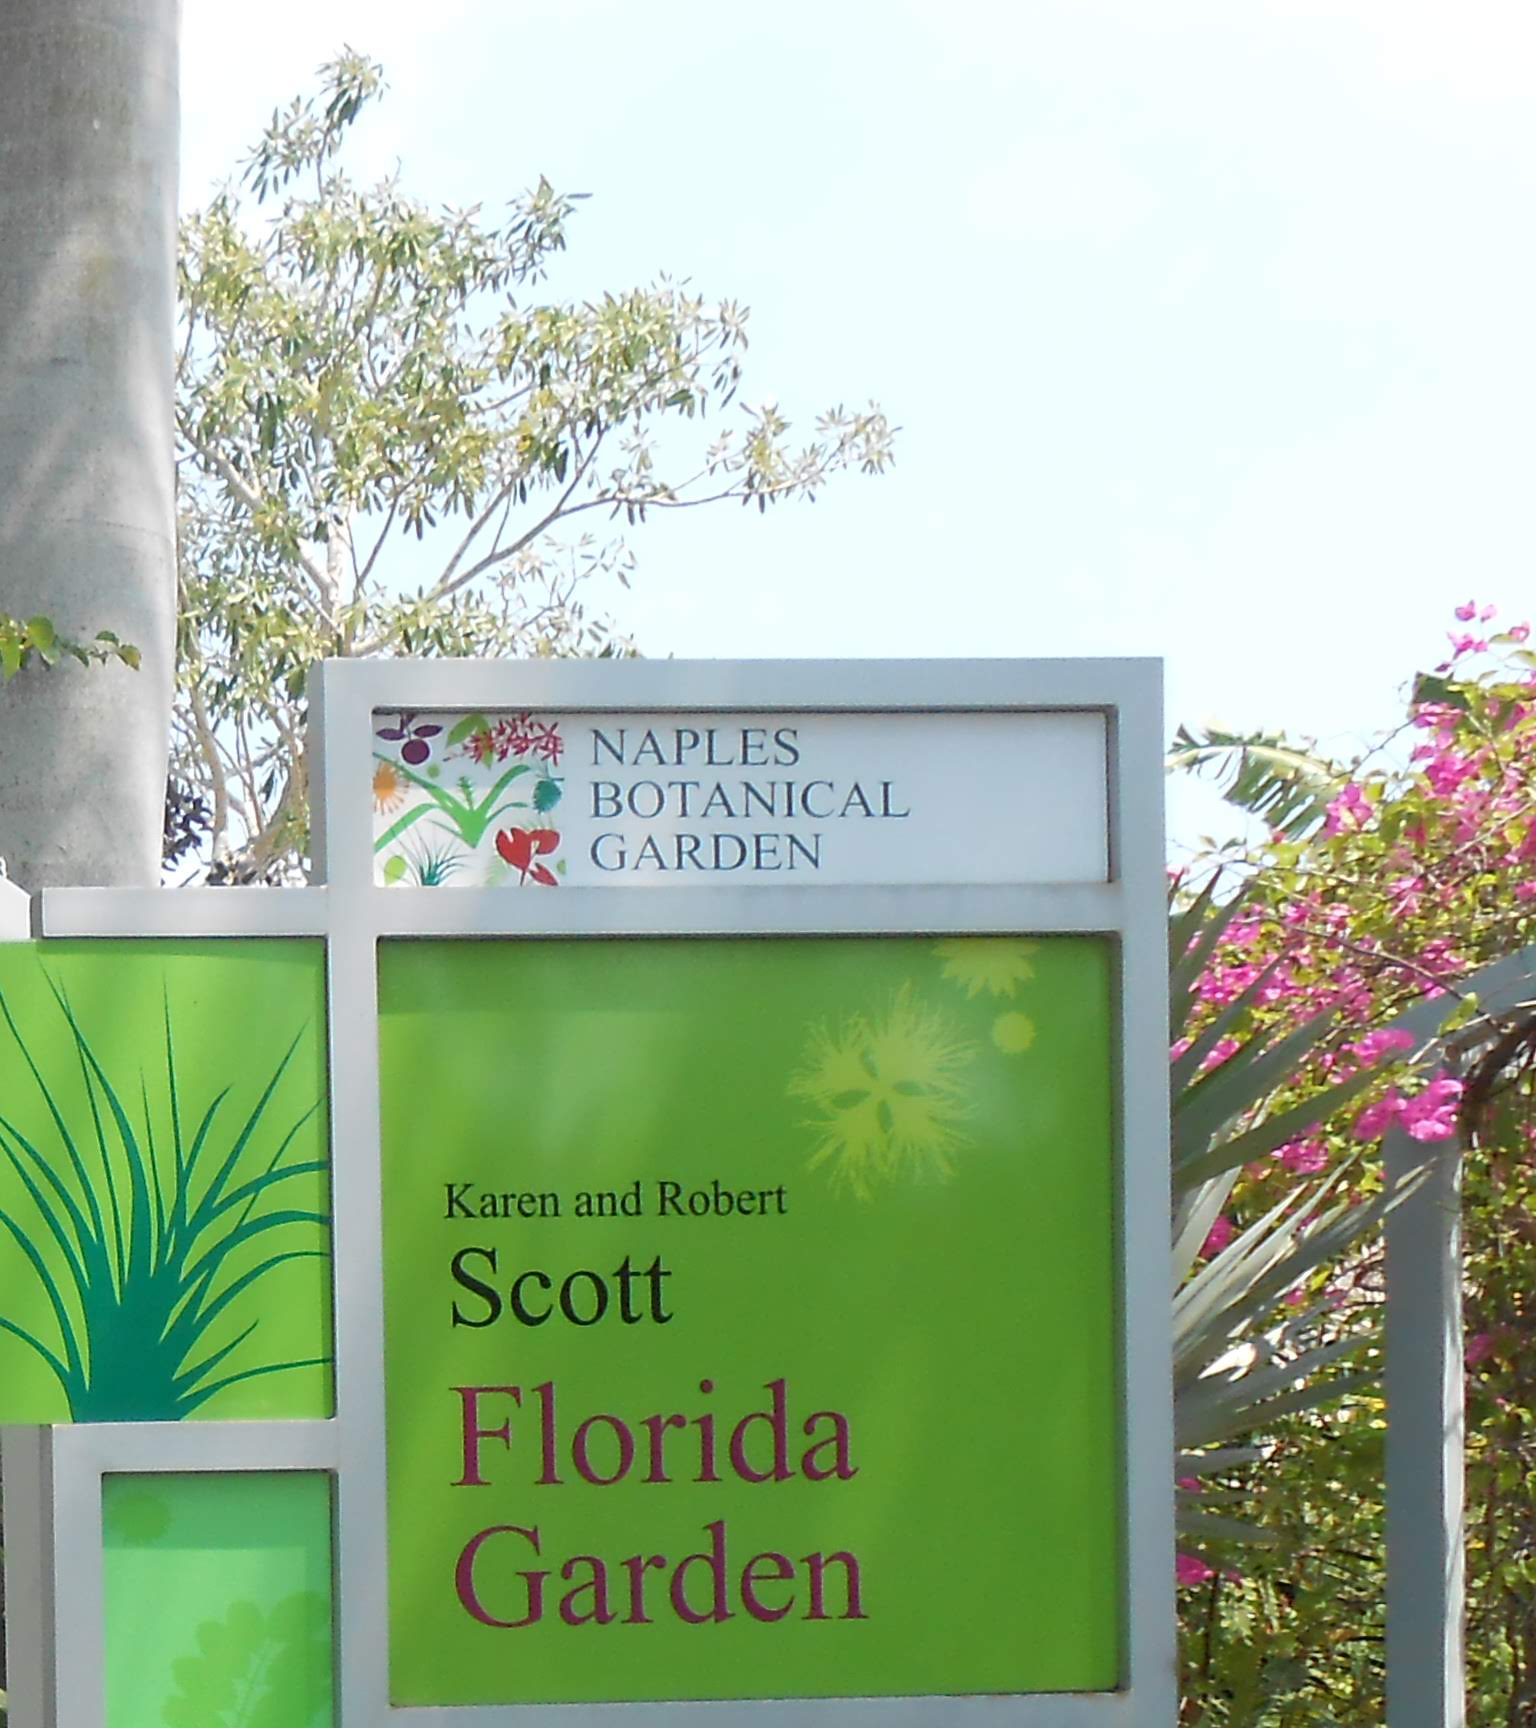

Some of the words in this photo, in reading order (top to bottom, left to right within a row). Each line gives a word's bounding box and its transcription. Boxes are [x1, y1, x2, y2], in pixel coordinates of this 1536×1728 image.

[590, 728, 800, 767] NAPLES
[590, 780, 910, 819] BOTANICAL
[590, 833, 822, 871] GARDEN
[444, 1182, 560, 1219] Karen
[575, 1181, 642, 1218] and
[657, 1180, 788, 1216] Robert
[450, 1246, 673, 1330] Scott
[450, 1378, 859, 1488] Florida
[454, 1521, 869, 1629] Garden
